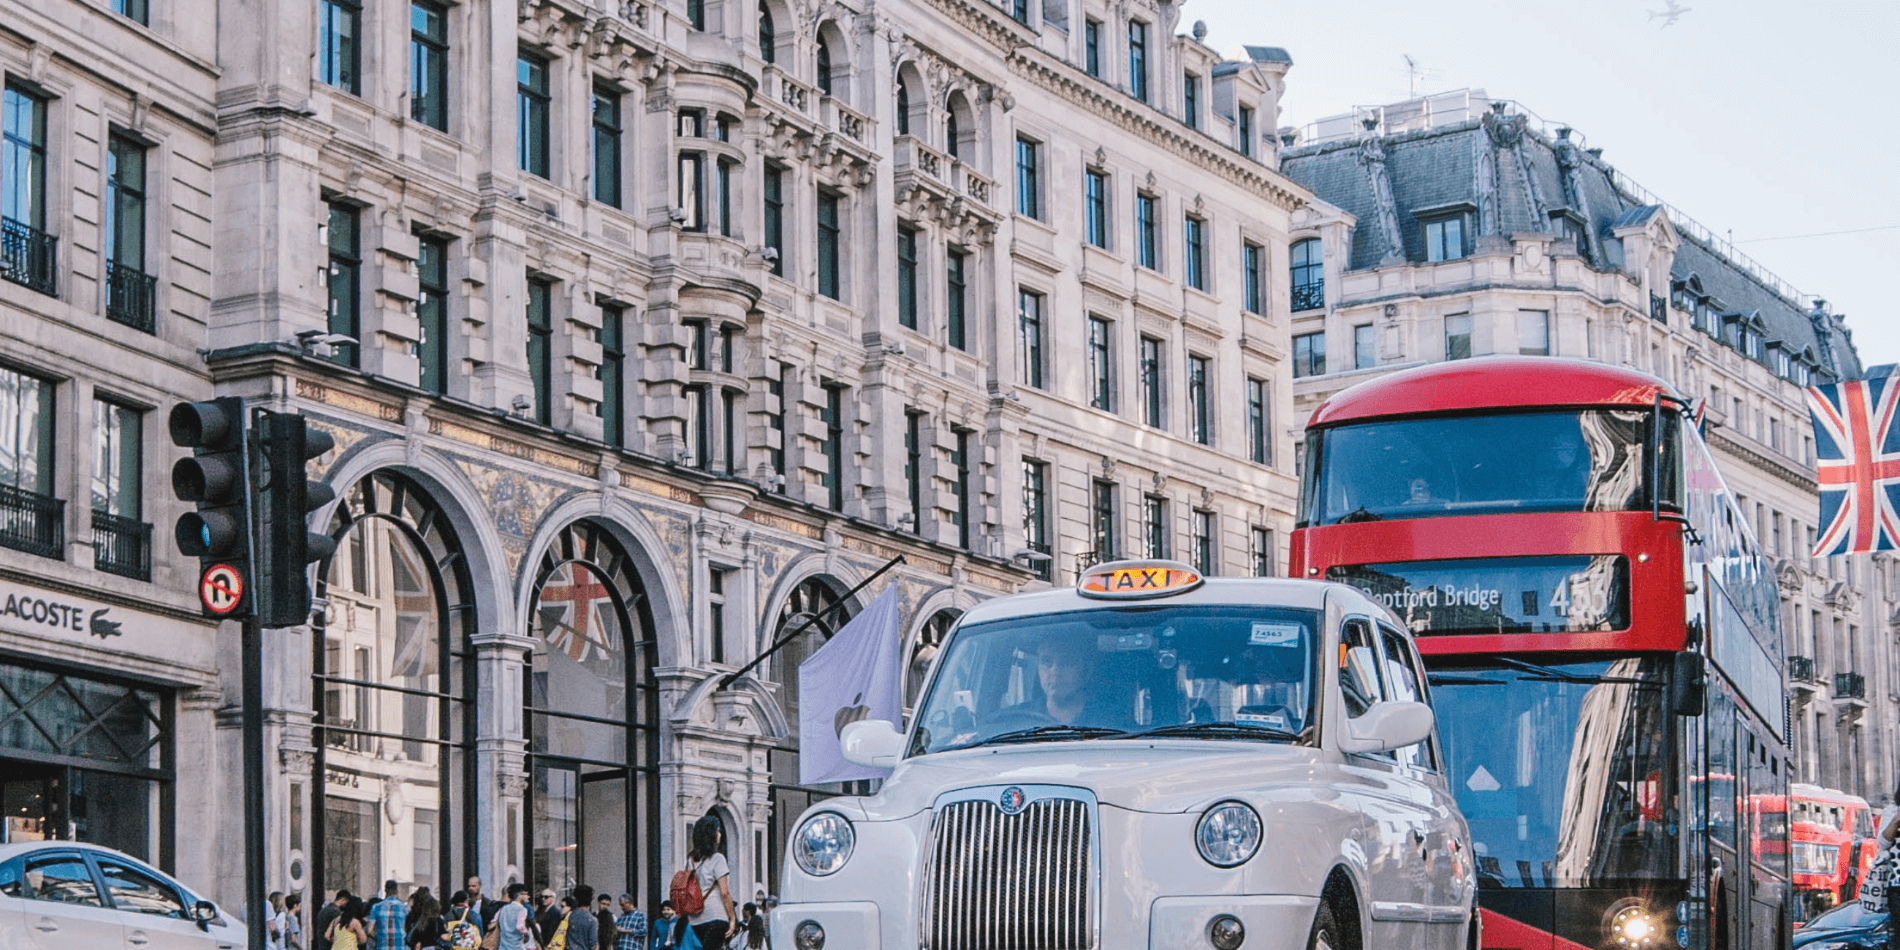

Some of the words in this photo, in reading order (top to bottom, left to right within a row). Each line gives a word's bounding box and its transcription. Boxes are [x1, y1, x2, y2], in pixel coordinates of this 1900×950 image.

[1101, 570, 1171, 591] TAXI
[1445, 583, 1499, 611] Bridge
[0, 593, 83, 631] ACOSTE
